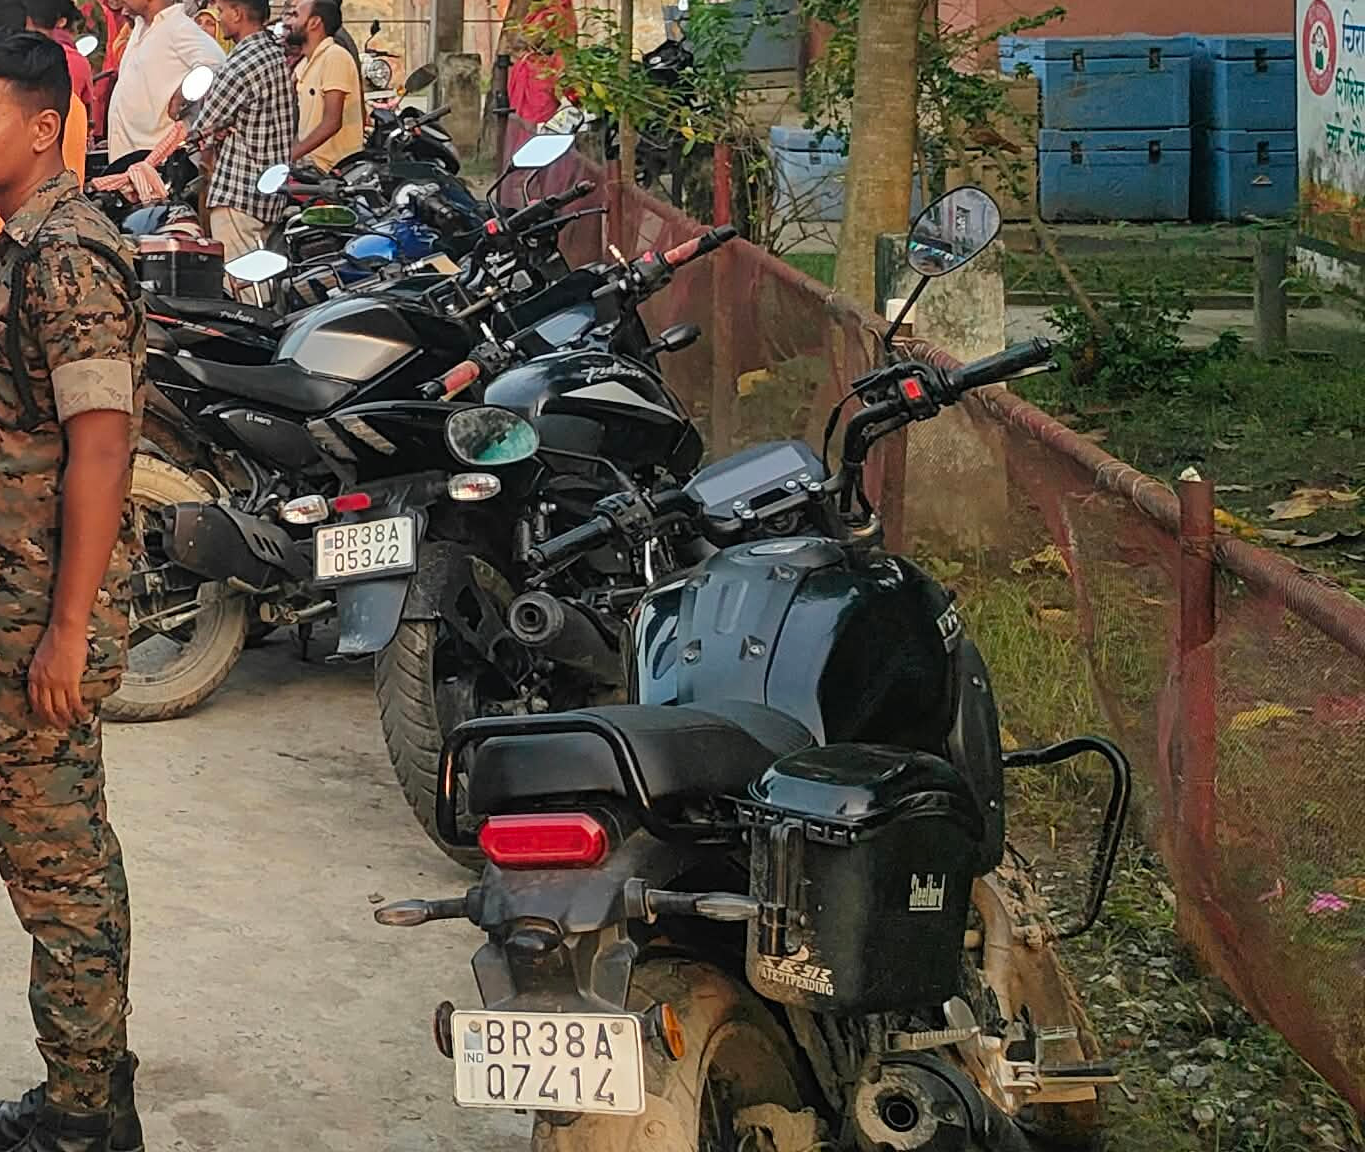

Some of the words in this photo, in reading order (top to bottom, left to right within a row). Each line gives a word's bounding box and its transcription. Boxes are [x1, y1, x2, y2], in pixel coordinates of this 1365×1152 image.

[1341, 8, 1365, 56] चिरा
[334, 522, 400, 550] BR38A
[334, 544, 400, 572] Q5342
[486, 1019, 613, 1061] BR38A
[486, 1063, 616, 1107] Q7414
